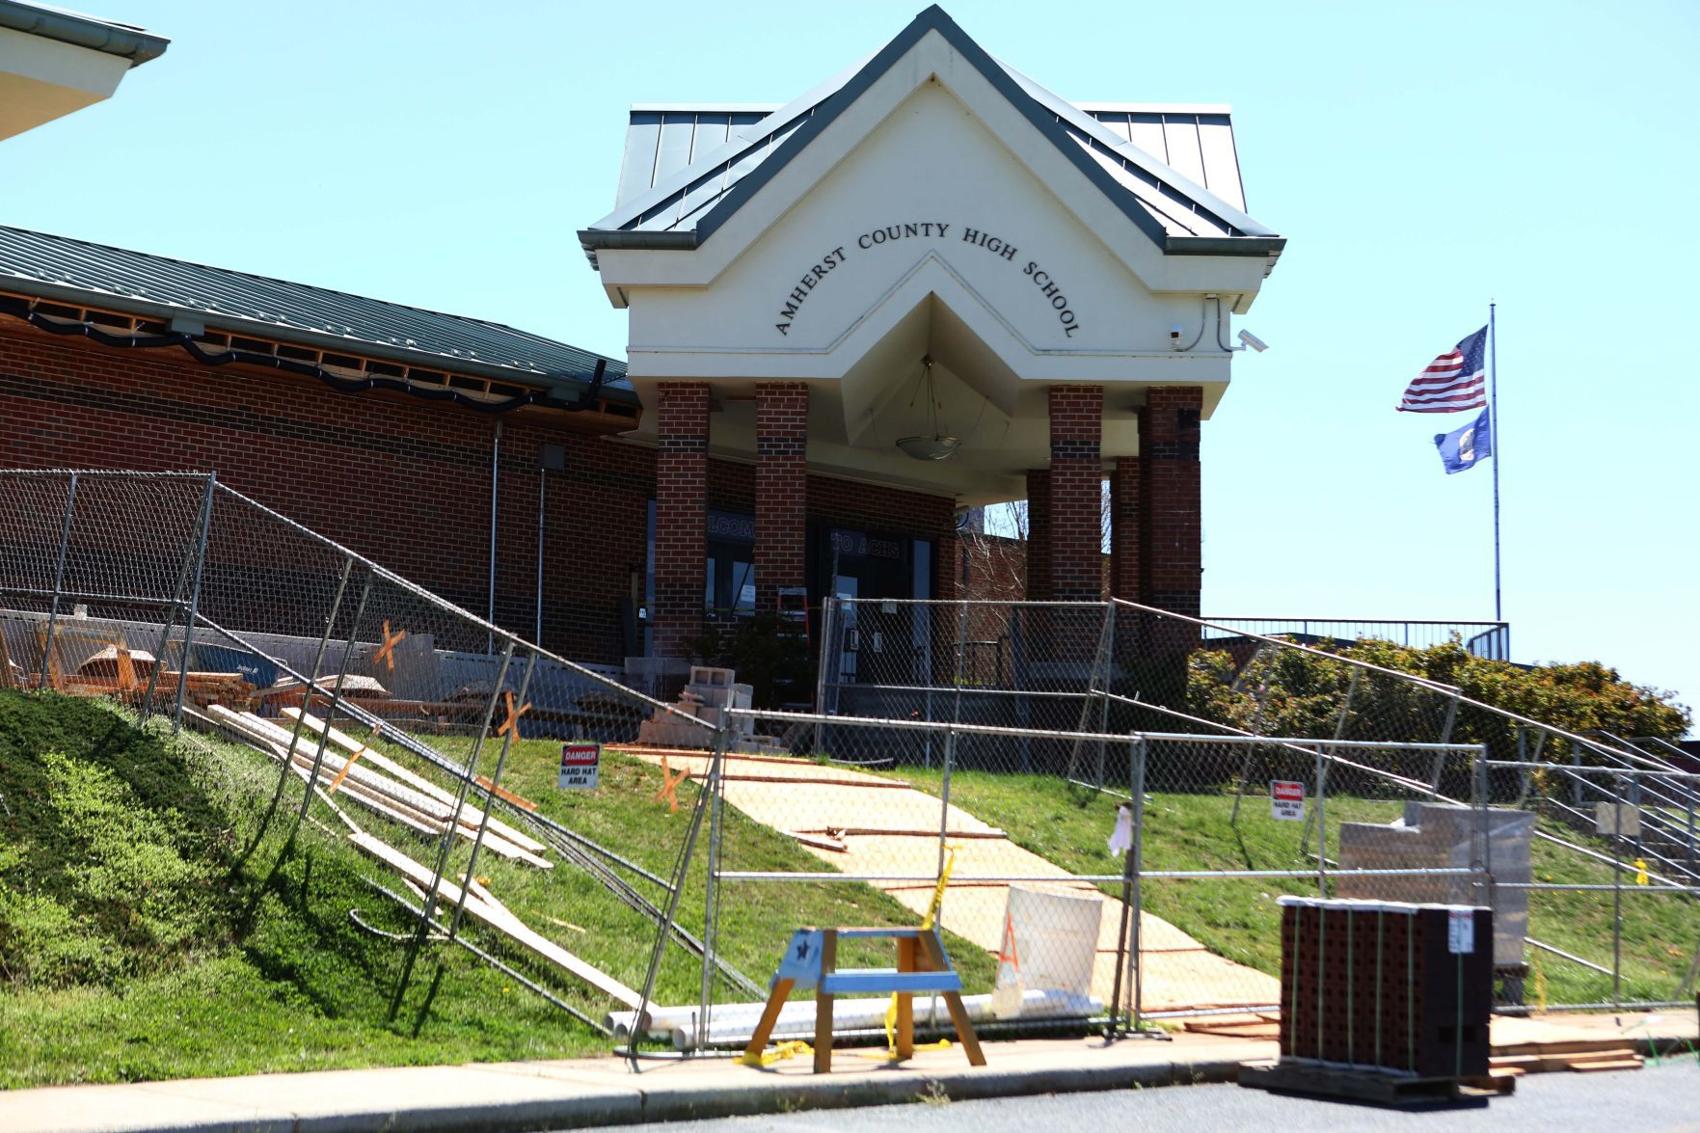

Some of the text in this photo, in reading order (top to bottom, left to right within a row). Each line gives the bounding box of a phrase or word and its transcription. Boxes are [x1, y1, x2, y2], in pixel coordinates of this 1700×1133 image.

[775, 222, 1081, 338] AMHERST COUNTY HIGH SCHOOL
[565, 750, 597, 761] DANGER
[561, 767, 596, 776] HARD HAT
[568, 776, 587, 785] AREA
